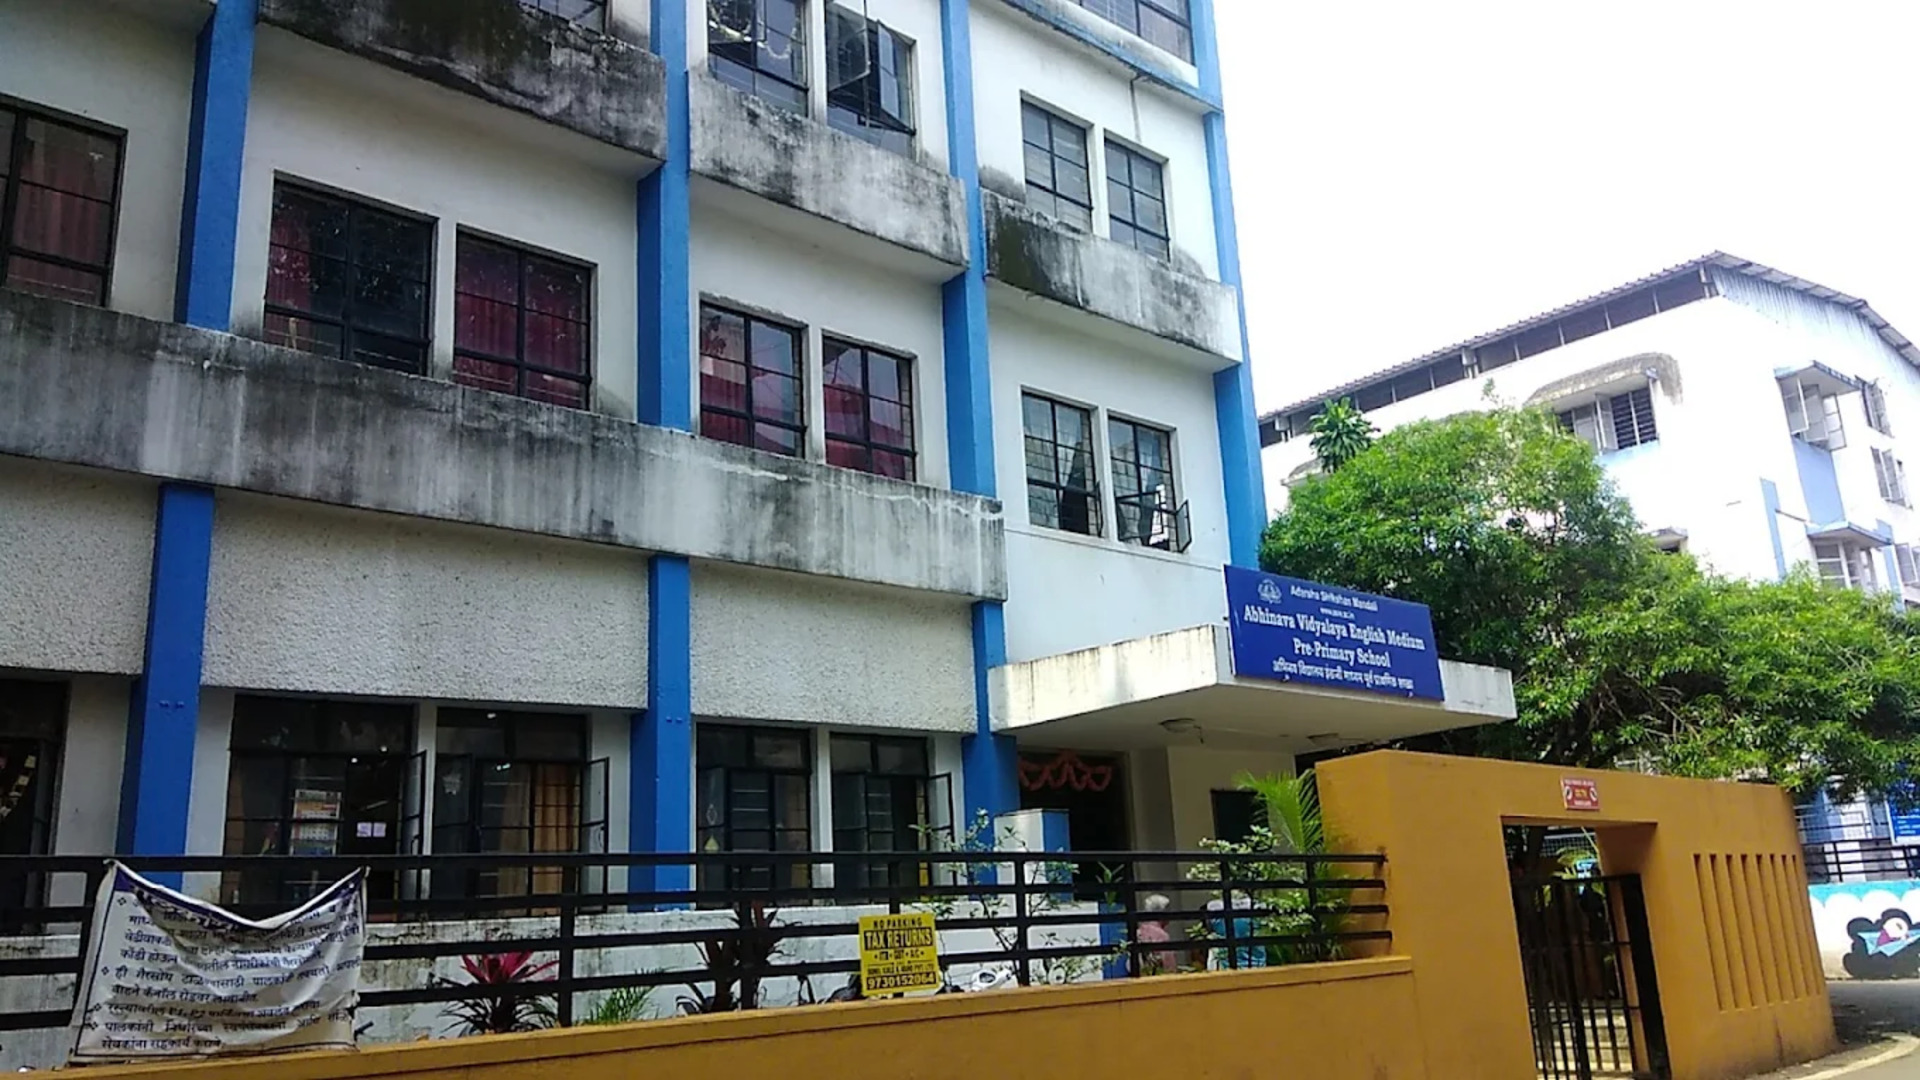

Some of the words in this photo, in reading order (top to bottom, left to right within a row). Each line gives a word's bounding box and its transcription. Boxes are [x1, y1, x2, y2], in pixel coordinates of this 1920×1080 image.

[1243, 604, 1296, 628] Abhinava
[1297, 614, 1348, 641] Vidyalaya
[1349, 624, 1386, 646] English
[1387, 630, 1426, 651] Medium
[1292, 637, 1356, 666] Pre-Primary
[1356, 647, 1391, 668] School
[873, 920, 885, 929] NO
[887, 917, 923, 929] PARKING
[865, 931, 886, 949] TAX
[887, 928, 932, 948] RETURNS
[114, 964, 128, 979] ही
